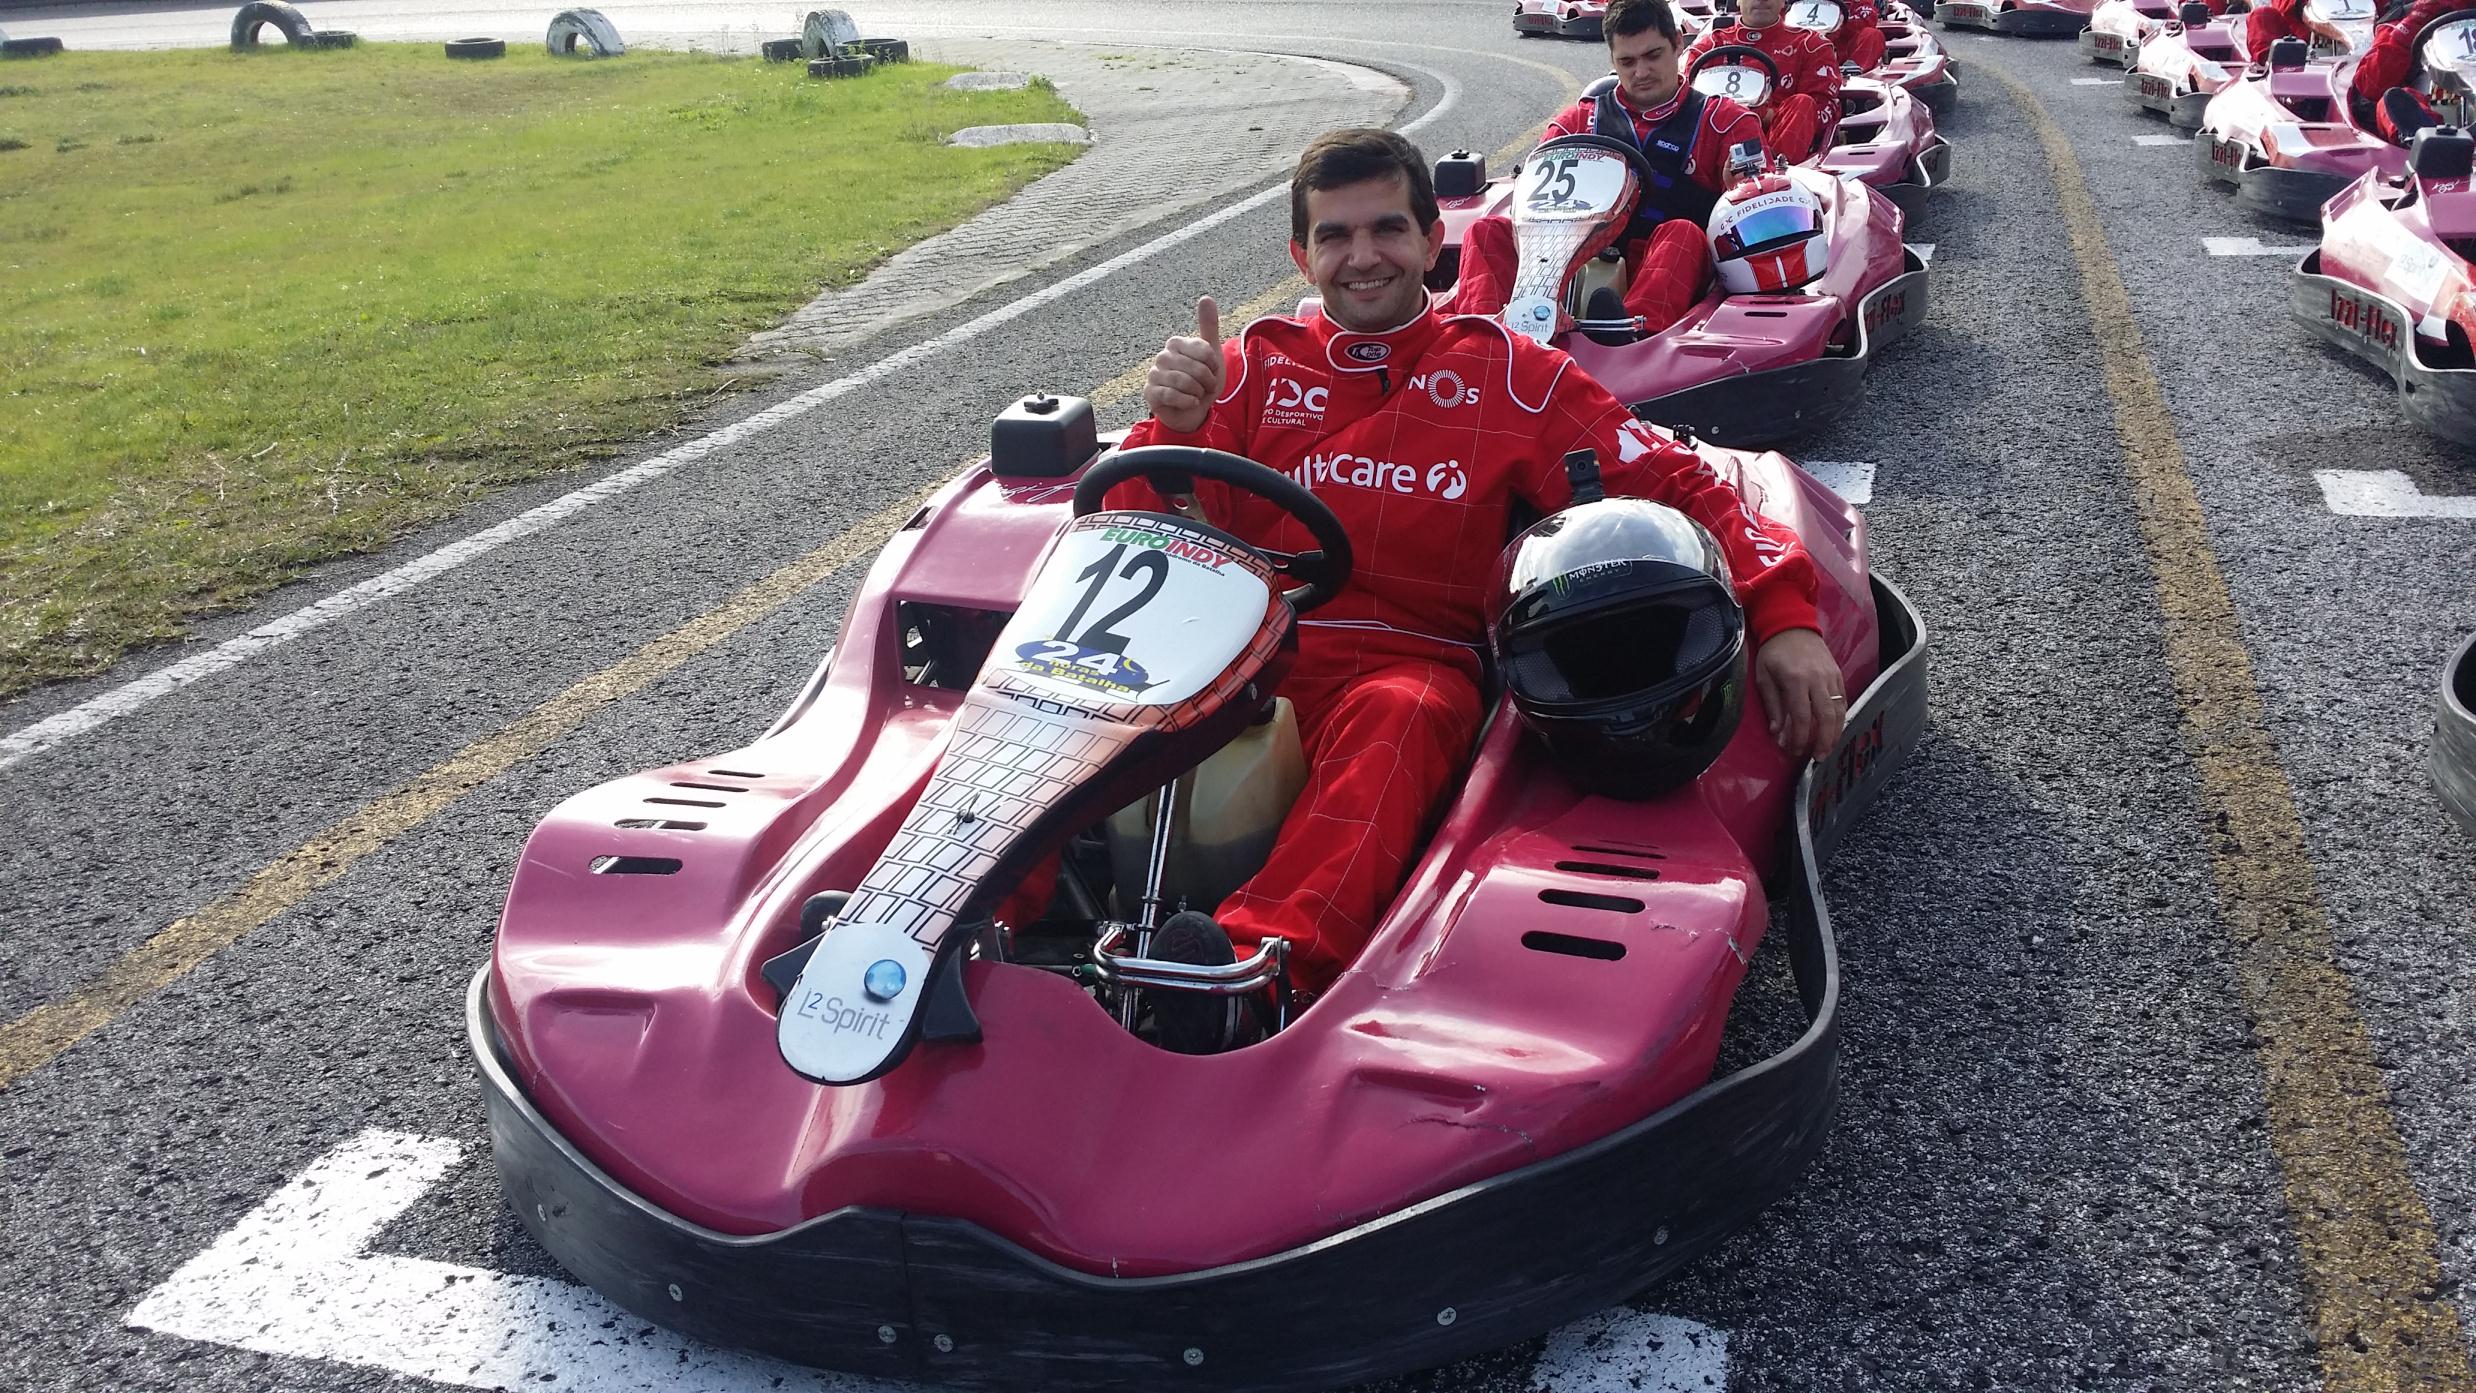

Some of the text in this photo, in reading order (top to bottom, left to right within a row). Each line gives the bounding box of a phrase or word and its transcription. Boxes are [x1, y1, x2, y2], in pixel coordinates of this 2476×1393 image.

[1806, 3, 1819, 22] 4
[1725, 71, 1742, 95] 8
[1526, 159, 1579, 201] 25
[1267, 416, 1306, 427] CULTURAL
[1275, 409, 1324, 420] DESPORTIVO
[1100, 527, 1233, 569] EUROINDY
[1052, 543, 1169, 656] 12
[1031, 640, 1119, 676] 24
[1050, 666, 1131, 694] Batalha
[821, 997, 890, 1040] Spirit
